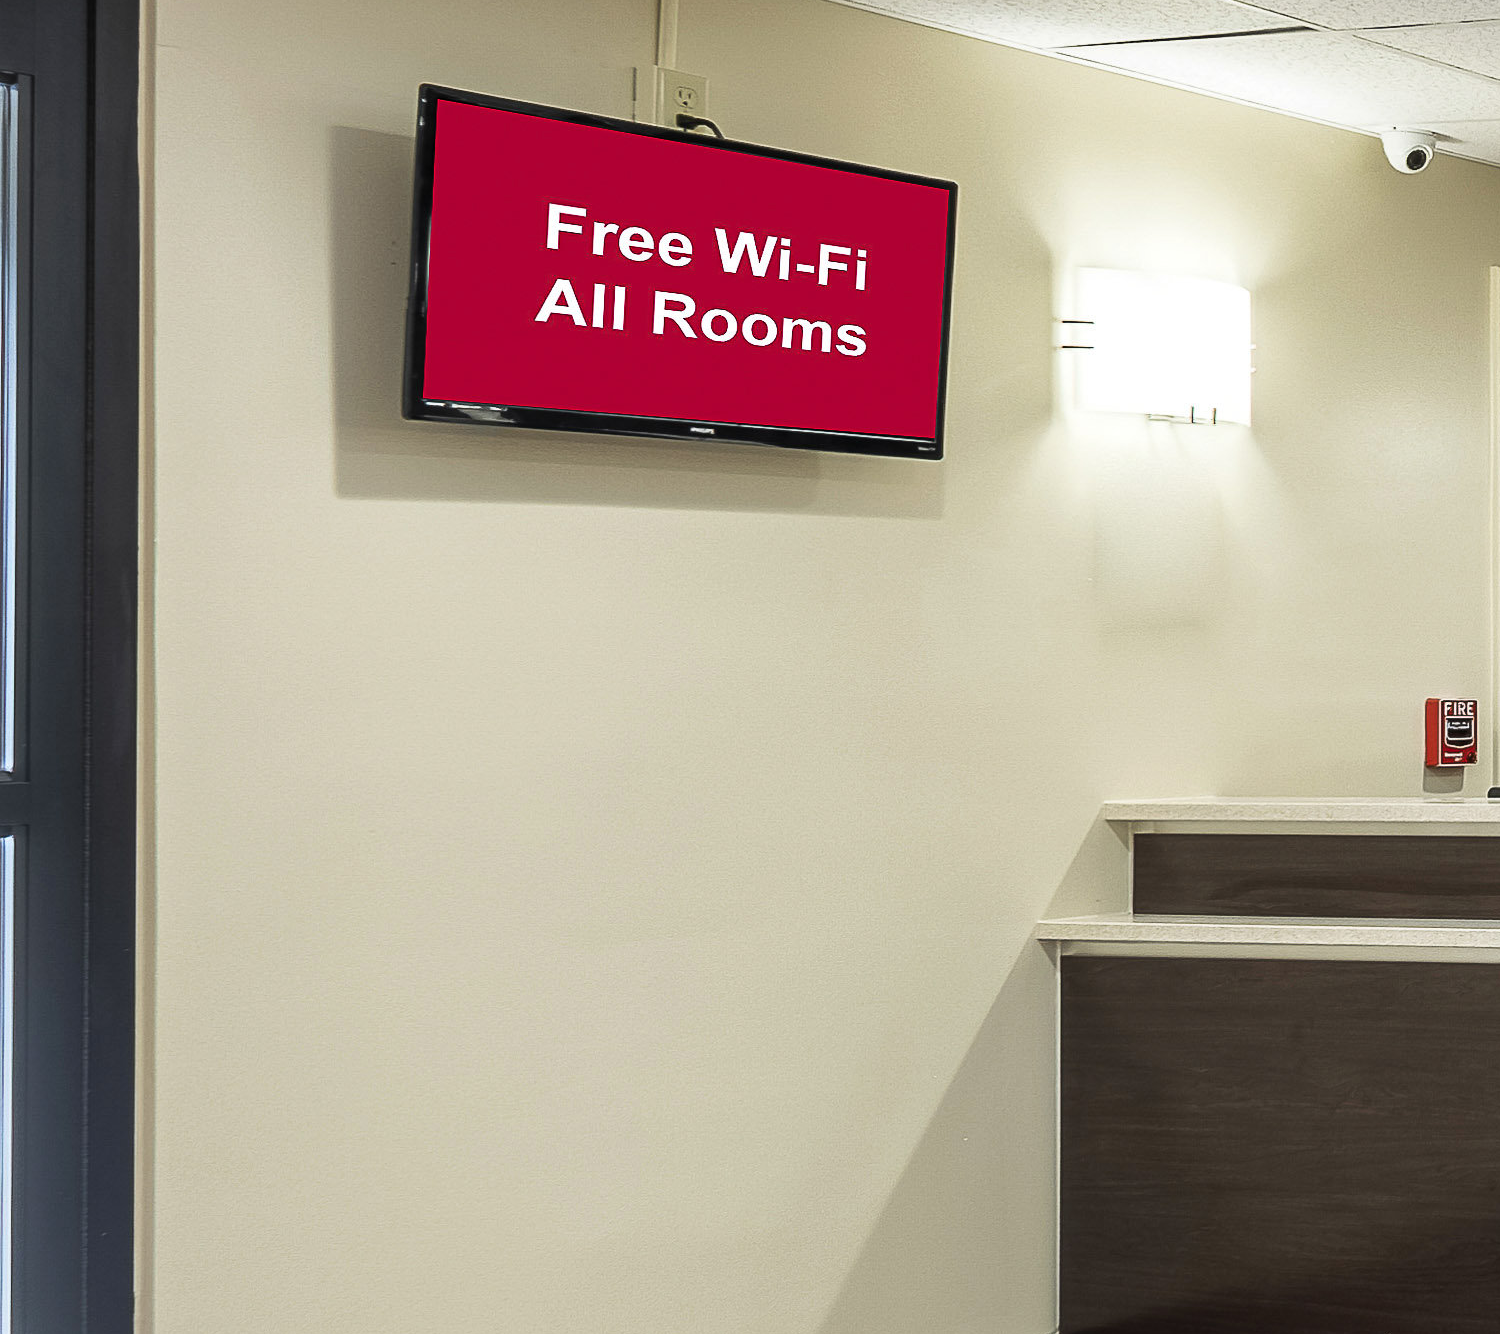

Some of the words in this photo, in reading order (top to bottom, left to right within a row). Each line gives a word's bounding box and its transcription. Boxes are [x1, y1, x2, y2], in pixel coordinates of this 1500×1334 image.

[546, 202, 693, 267] Free
[714, 227, 867, 291] Wi-Fi
[534, 278, 626, 331] All
[652, 290, 867, 357] Rooms
[1444, 701, 1475, 716] FIRE
